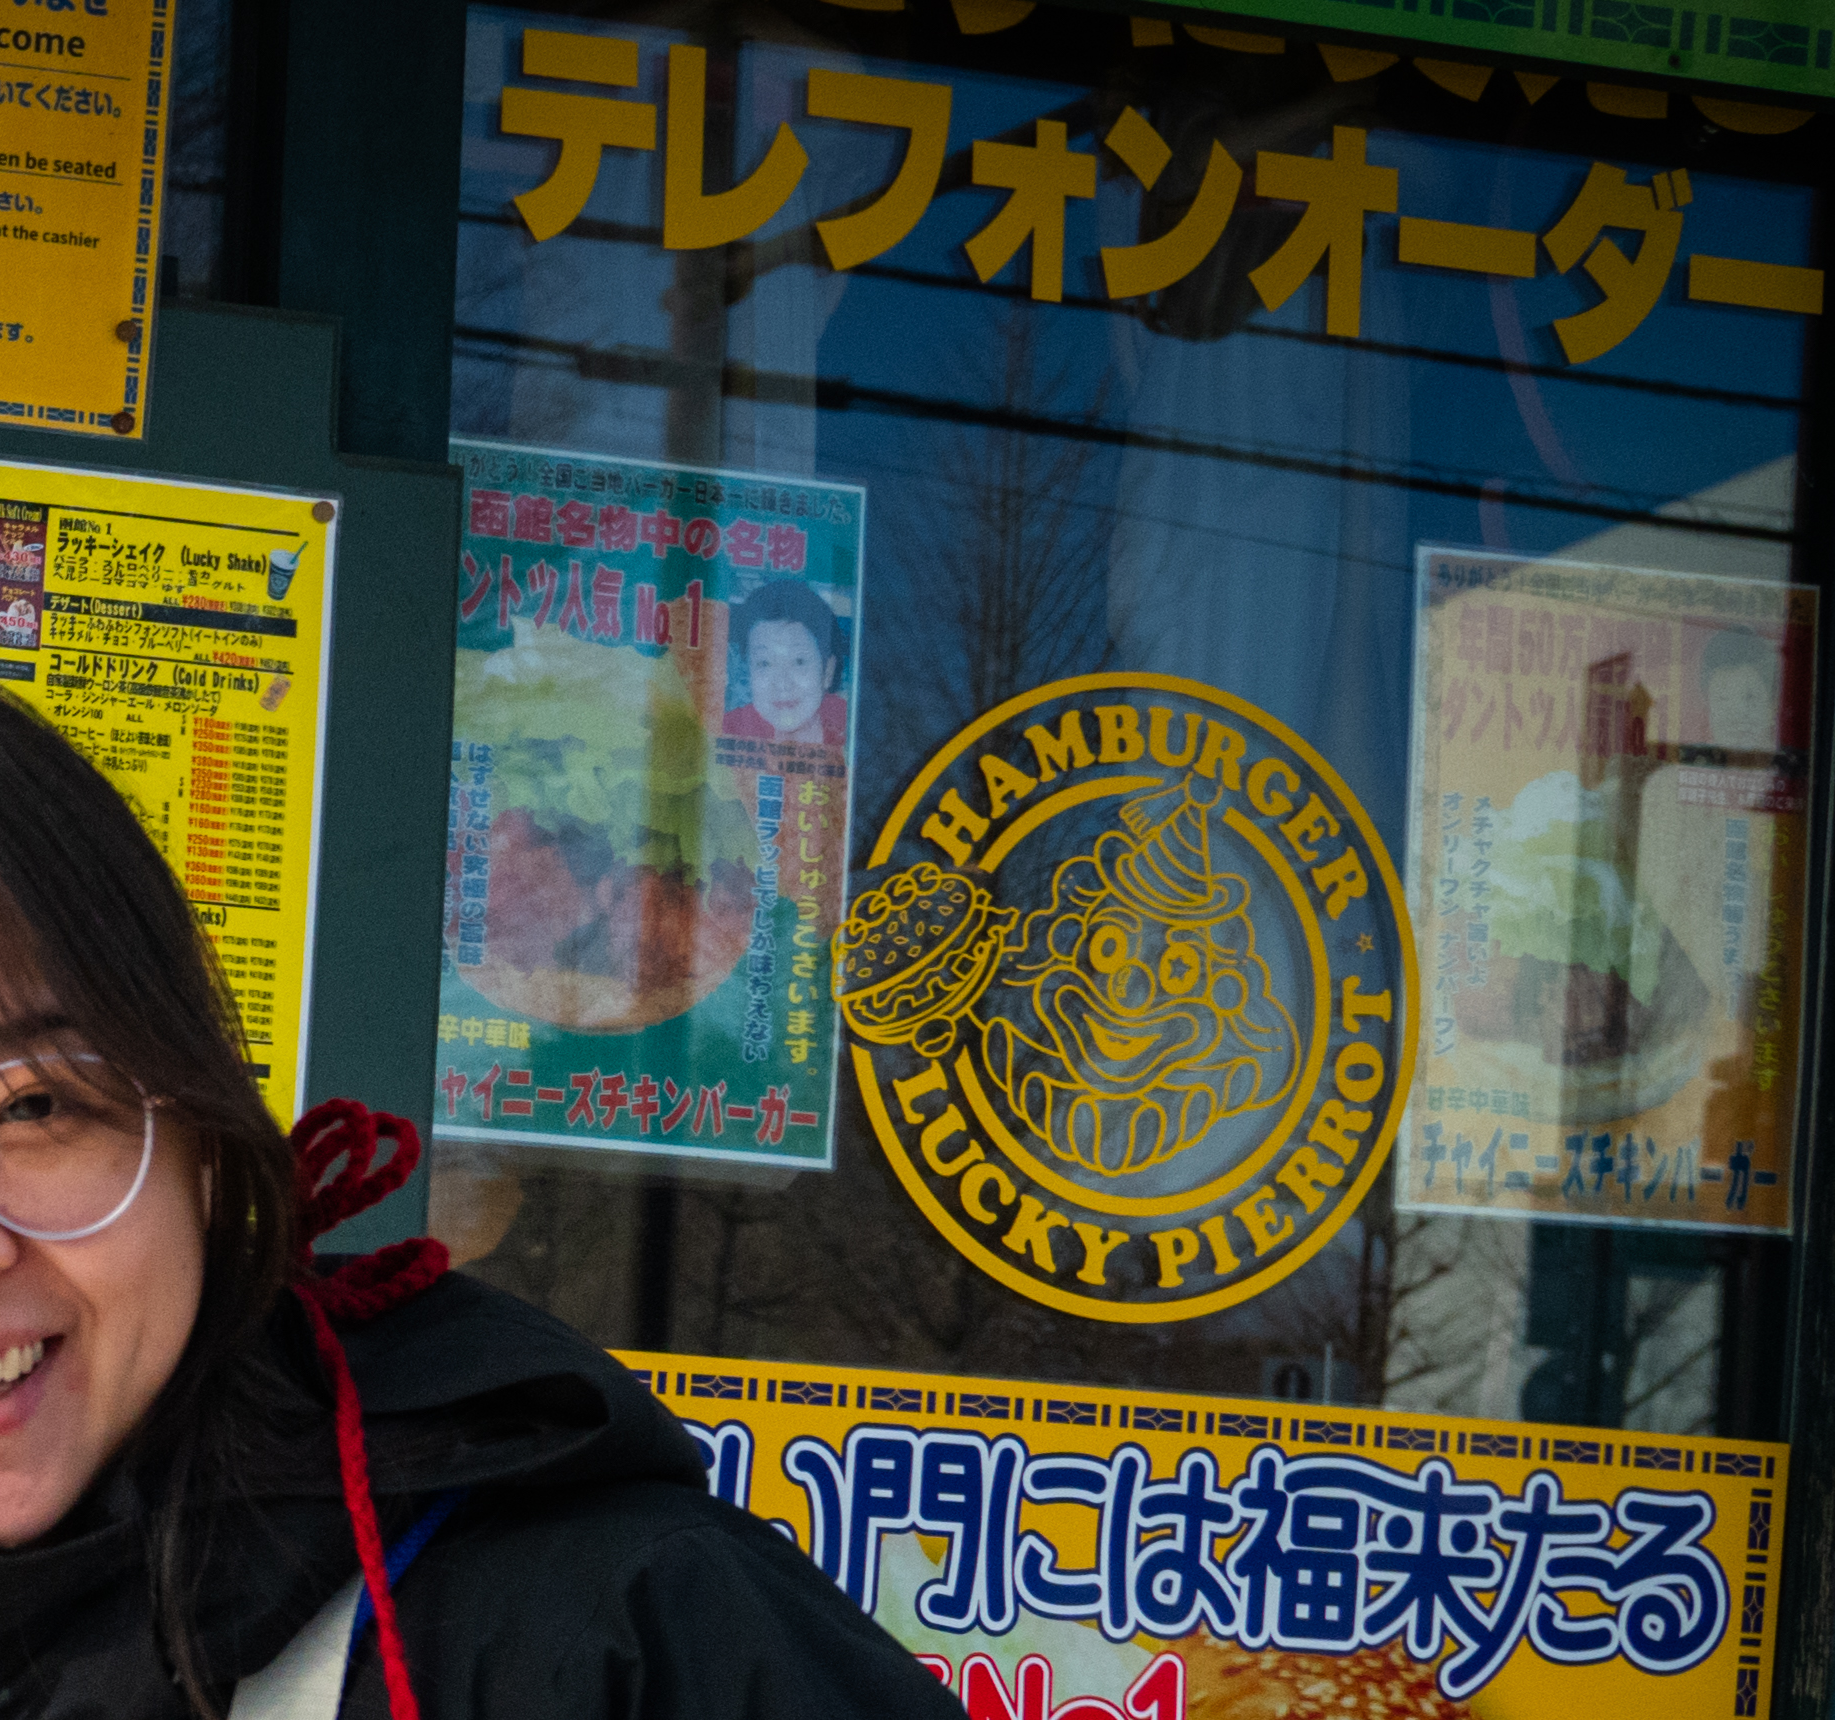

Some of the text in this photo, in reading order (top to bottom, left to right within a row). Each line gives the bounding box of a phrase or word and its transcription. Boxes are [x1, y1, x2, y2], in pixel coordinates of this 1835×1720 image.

[25, 151, 48, 170] be
[53, 155, 116, 179] seated
[500, 27, 1825, 367] テレフォンオーダー
[12, 222, 39, 241] the
[42, 226, 100, 248] cashier
[58, 532, 165, 563] ラッキーシェイク
[468, 487, 808, 572] 函館名物中の名物
[50, 653, 158, 682] コールドドリンク
[921, 704, 1370, 919] HAMBURGER
[893, 975, 1391, 1288] LUCKY PIERROT
[683, 1418, 1729, 1701] い門には福来たる
